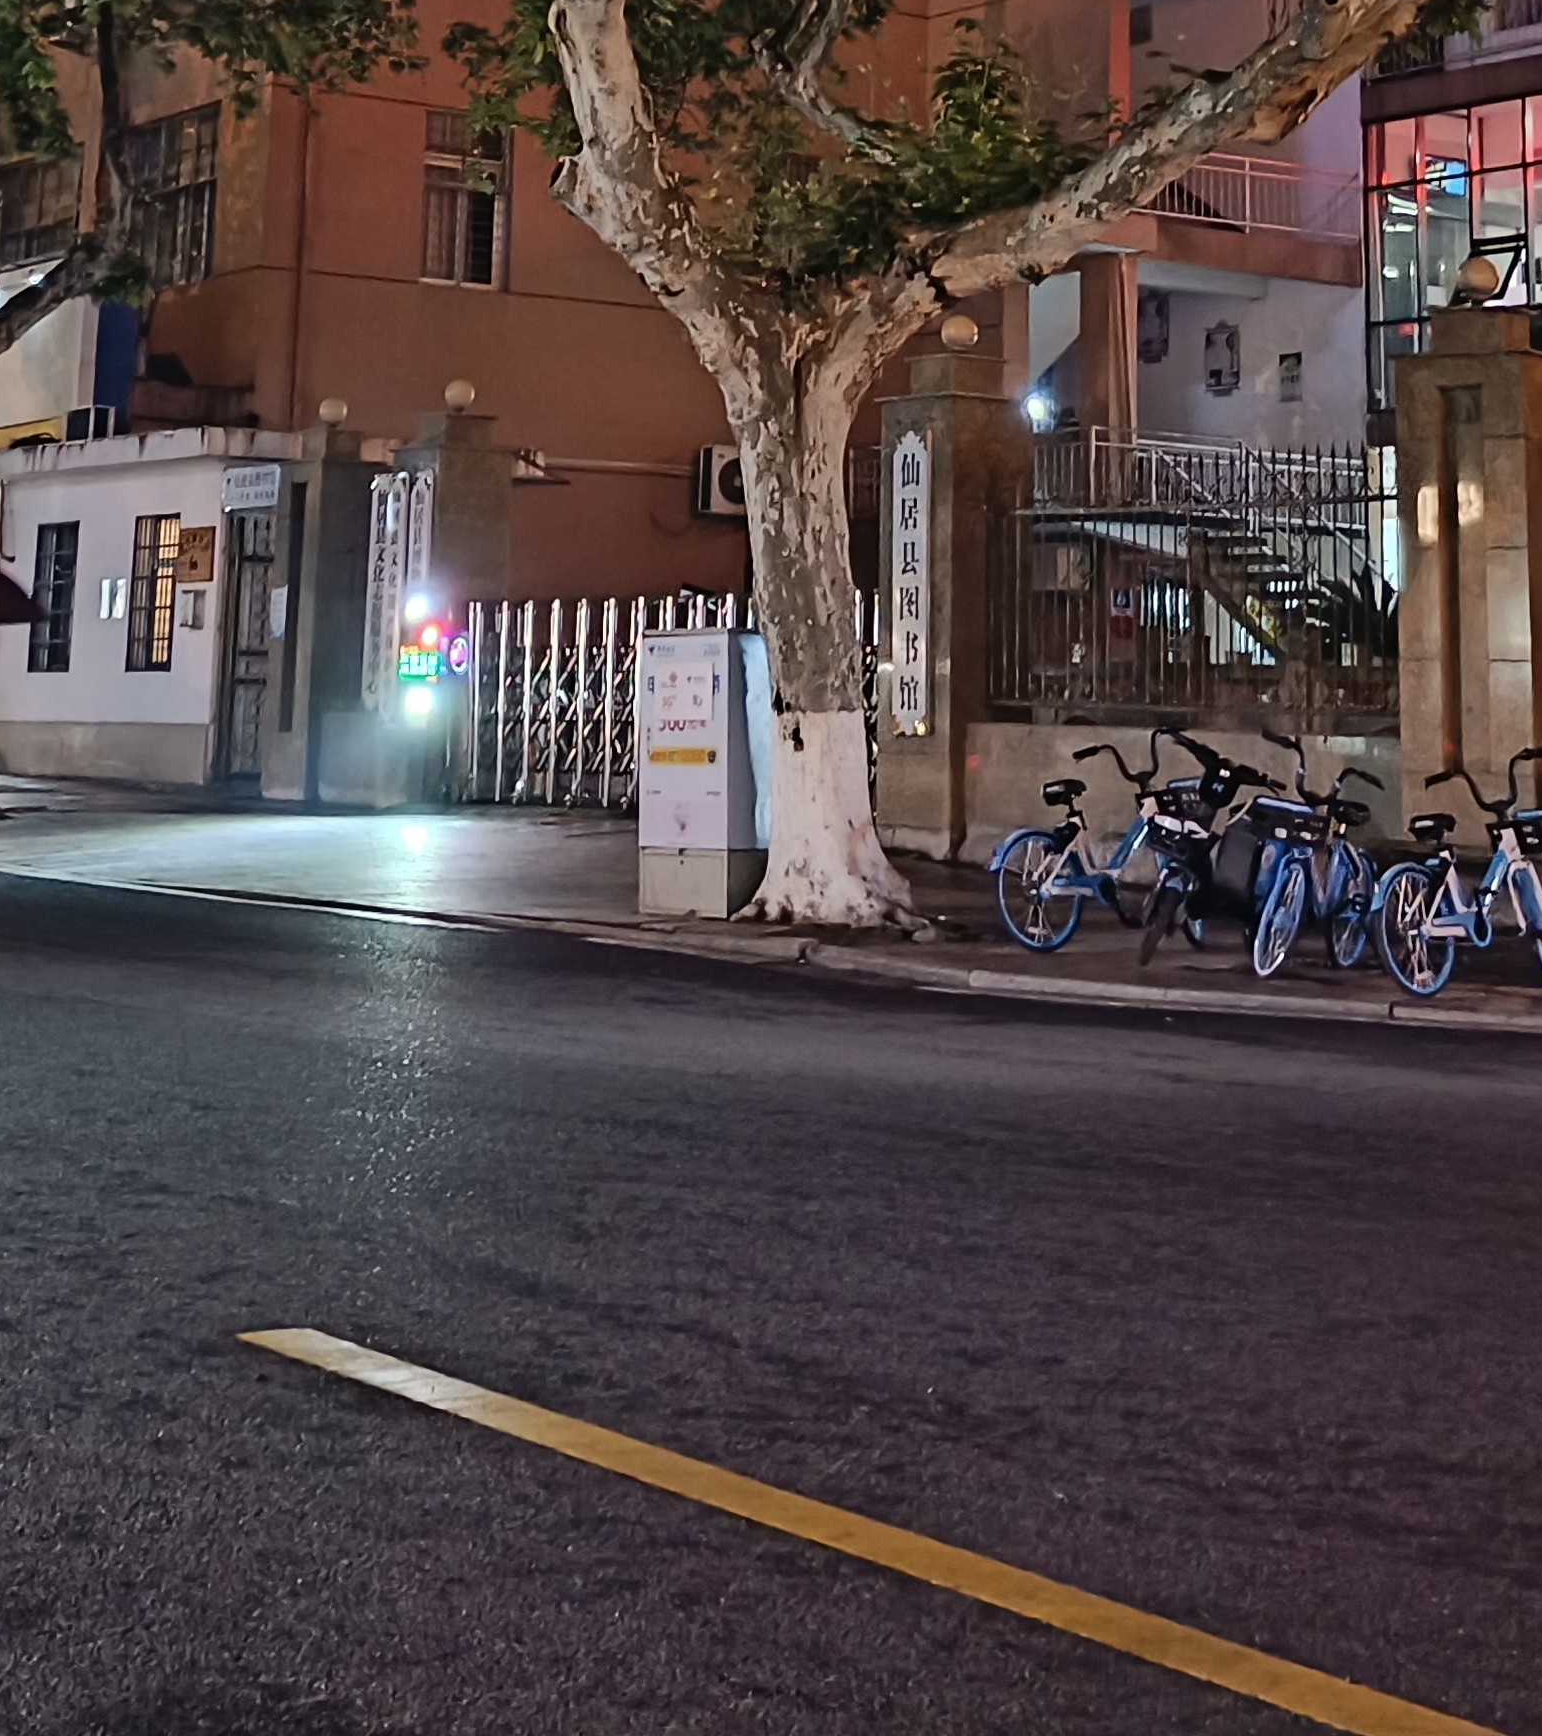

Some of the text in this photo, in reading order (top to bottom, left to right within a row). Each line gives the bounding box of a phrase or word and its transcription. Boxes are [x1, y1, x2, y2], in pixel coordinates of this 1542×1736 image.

[900, 452, 920, 711] 仙居县图书馆
